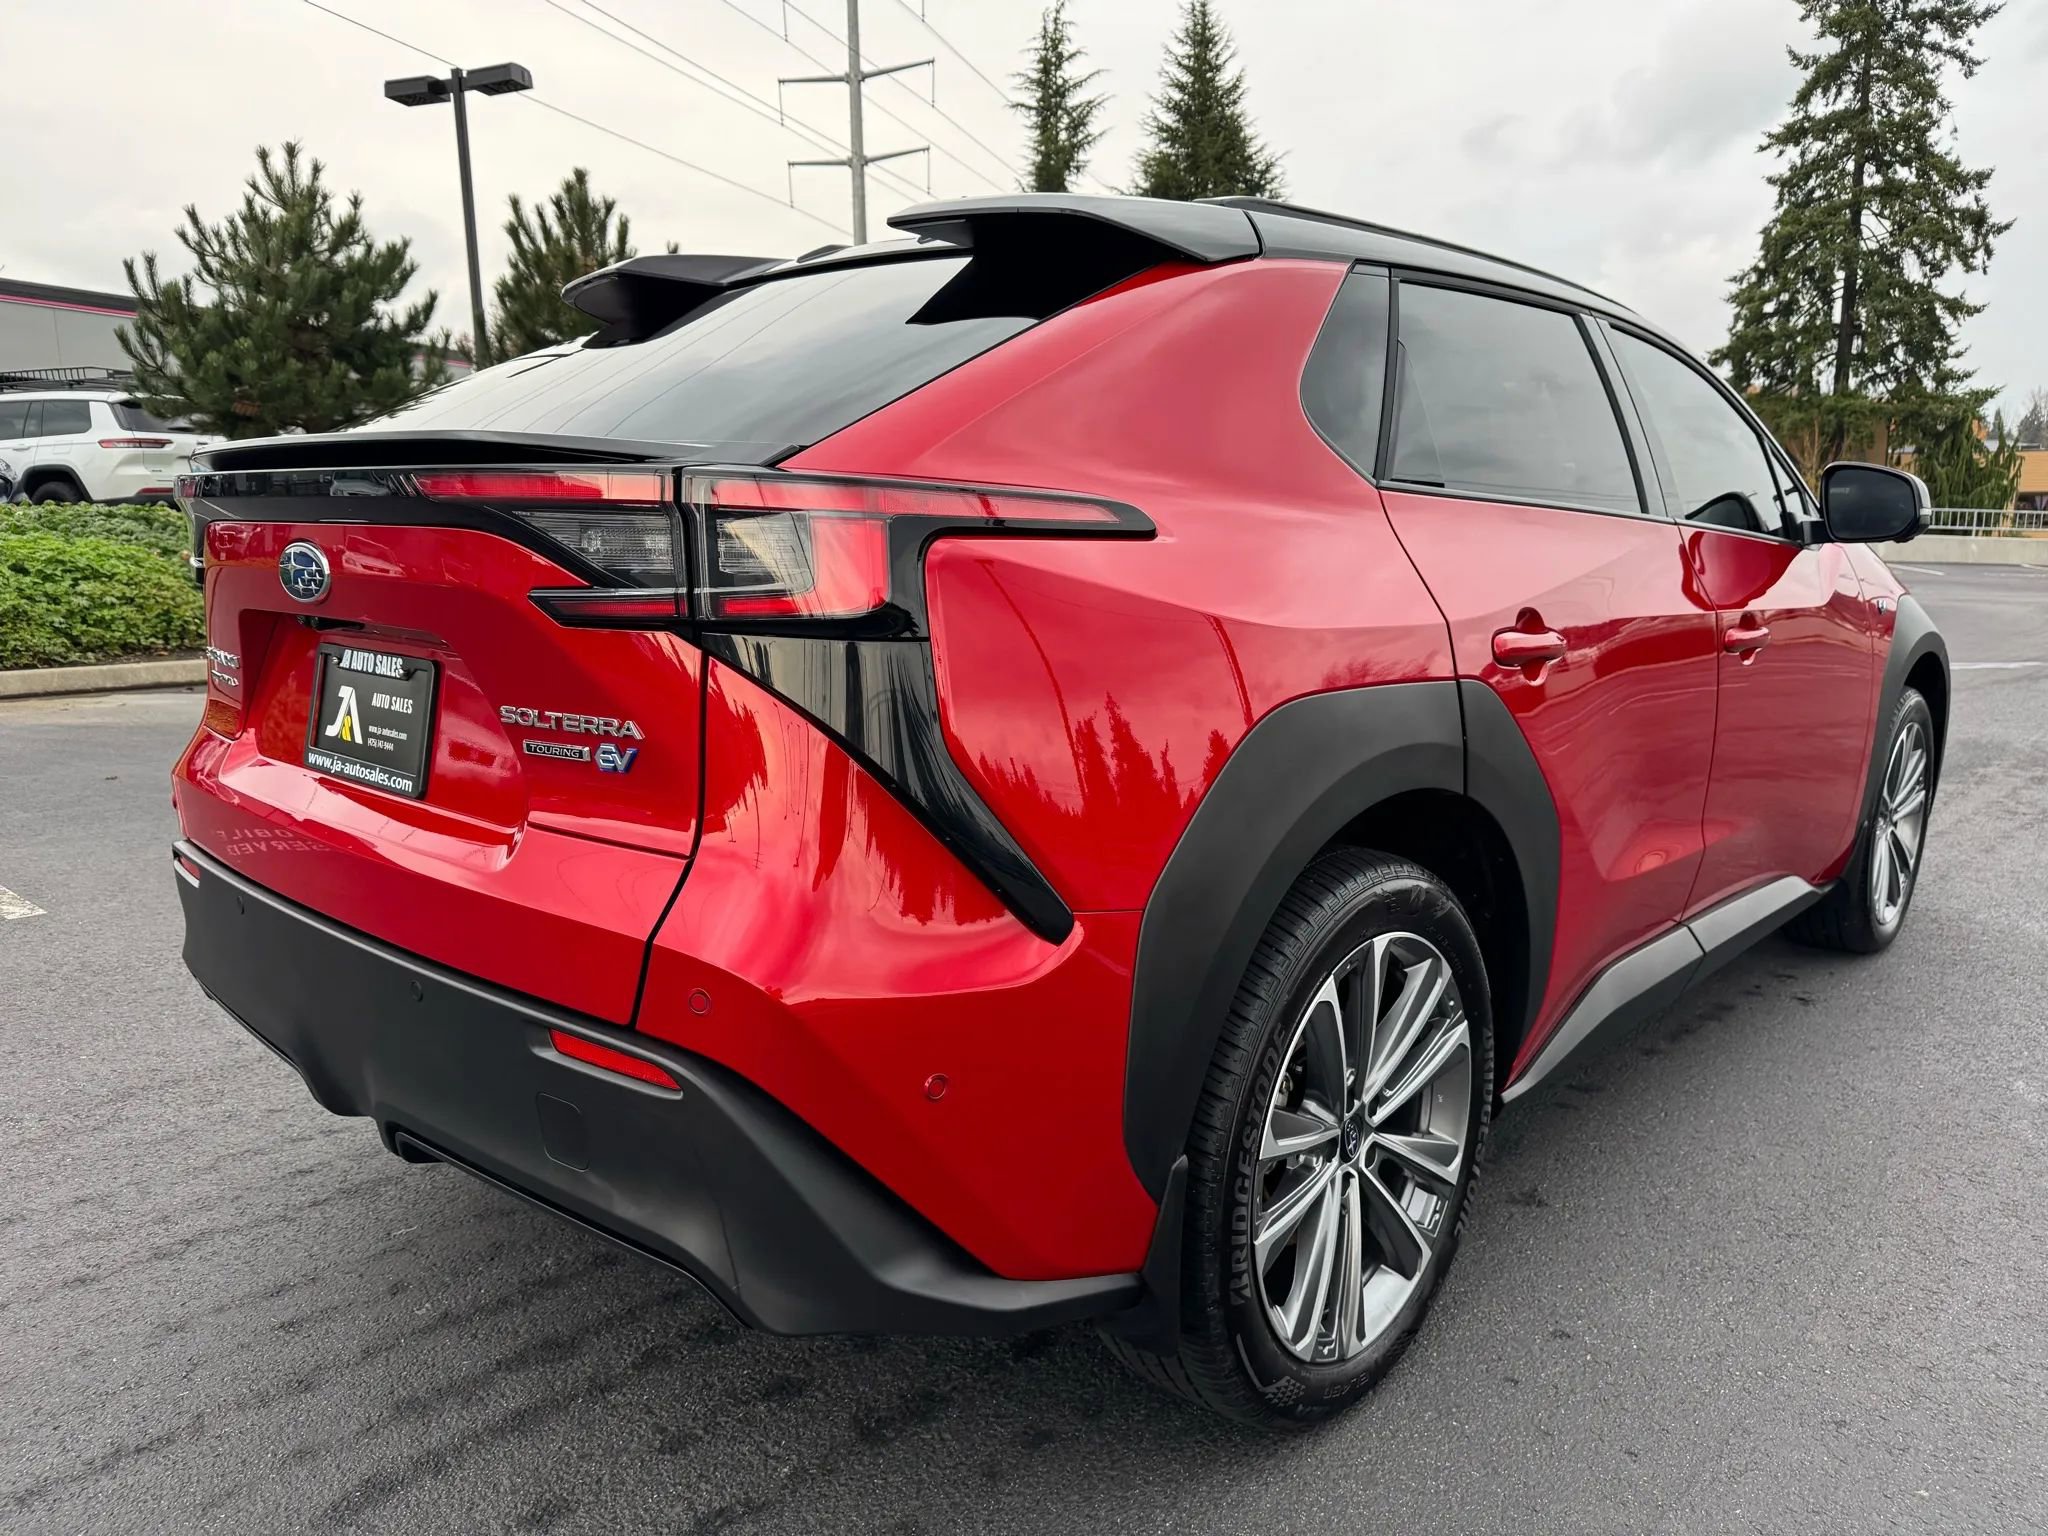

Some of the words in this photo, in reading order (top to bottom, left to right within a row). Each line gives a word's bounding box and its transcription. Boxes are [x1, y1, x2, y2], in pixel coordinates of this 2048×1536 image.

[351, 651, 374, 673] AUTO
[375, 655, 403, 678] SALES
[371, 692, 389, 709] AUTO
[391, 696, 413, 714] SALES
[499, 705, 646, 740] SOLTERRA
[529, 744, 580, 758] TOURING
[594, 743, 640, 773] EV
[308, 752, 413, 792] www.ja-autosales.com
[1230, 1021, 1288, 1305] BRIDGESTONE
